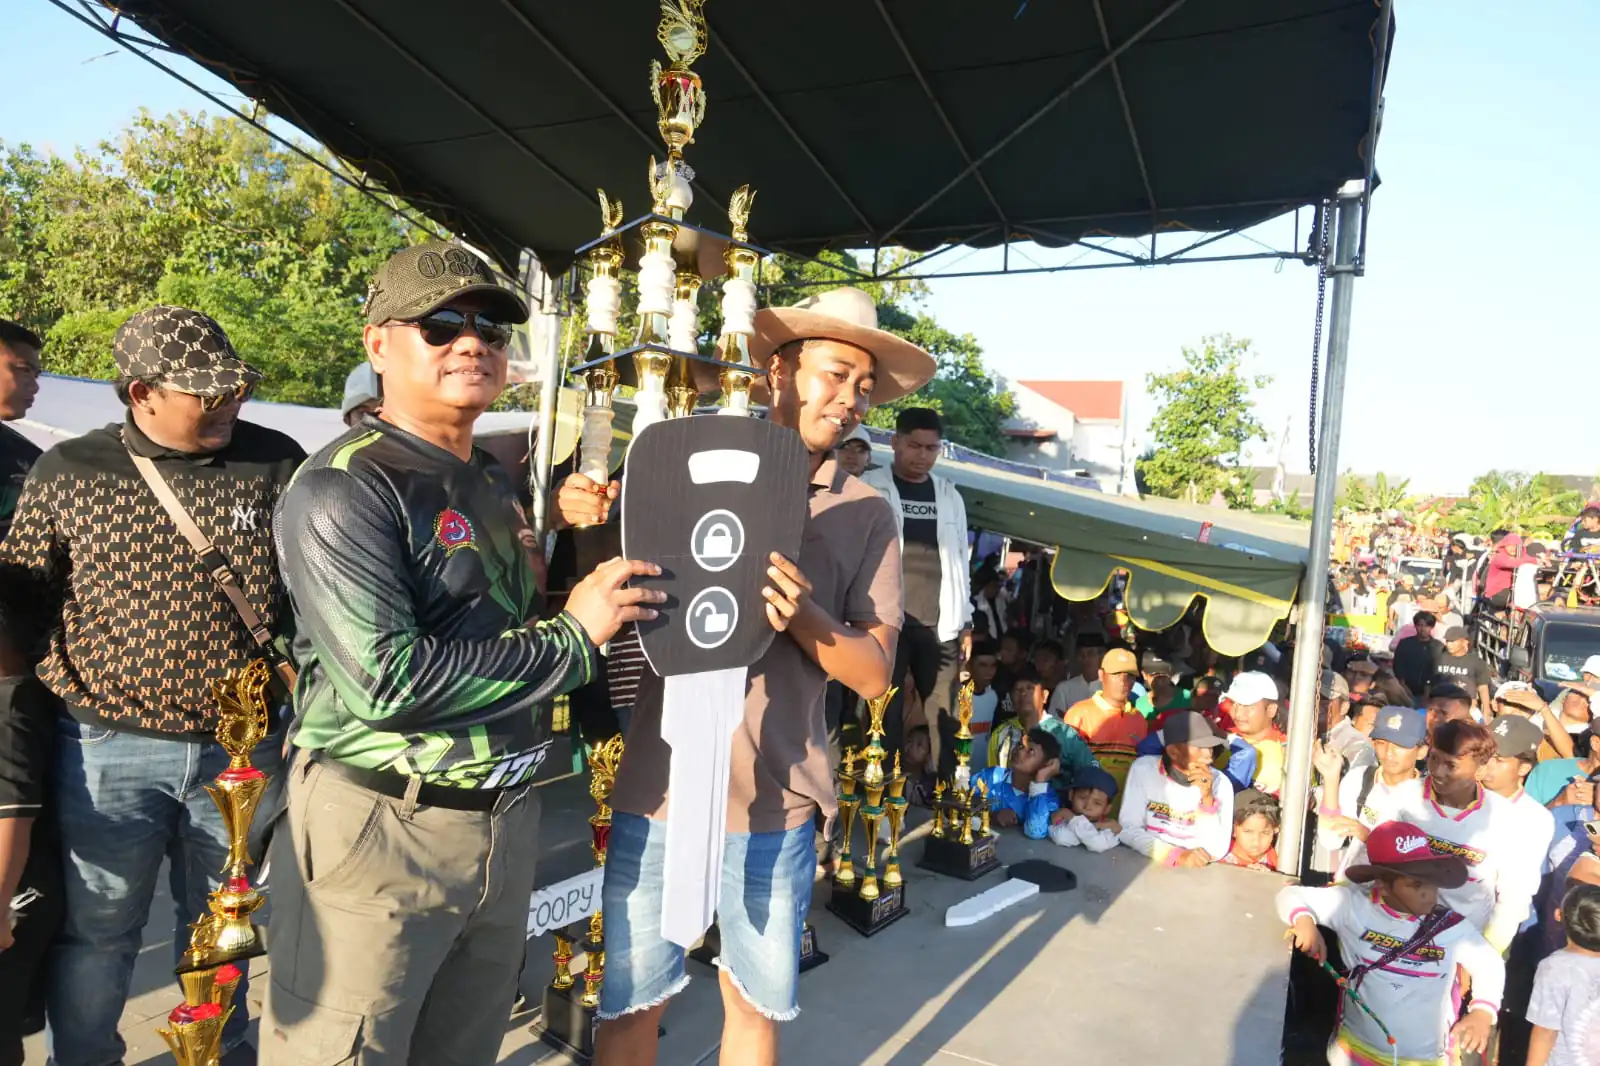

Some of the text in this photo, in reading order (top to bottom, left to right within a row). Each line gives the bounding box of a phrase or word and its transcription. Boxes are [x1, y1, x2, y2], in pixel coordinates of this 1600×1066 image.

[417, 248, 484, 278] 08
[76, 479, 97, 489] NY
[119, 480, 140, 489] NY
[196, 480, 216, 489] NY
[236, 481, 255, 490] NY
[58, 489, 76, 500] NY
[96, 488, 117, 496] NY
[216, 489, 236, 498] NY
[75, 497, 95, 506] NY
[116, 496, 137, 505] NY
[196, 497, 216, 506] NY
[60, 509, 76, 519] NY
[94, 505, 114, 514] NY
[136, 505, 157, 515] NY
[76, 515, 93, 525] NY
[113, 514, 134, 523] NY
[197, 516, 216, 526] NY
[93, 524, 111, 533] NY
[133, 524, 154, 533] NY
[216, 526, 234, 536] NY
[111, 532, 132, 542] NY
[154, 533, 175, 544] NY
[235, 536, 254, 545] NY
[93, 543, 110, 552] NY
[132, 543, 152, 552] NY
[174, 544, 195, 555] NY
[253, 546, 270, 556] NY
[111, 552, 131, 562] NY
[153, 553, 174, 562] NY
[234, 555, 253, 565] NY
[132, 562, 151, 572] NY
[173, 563, 194, 573] NY
[252, 565, 270, 575] NY
[115, 571, 132, 581] NY
[152, 571, 173, 581] NY
[133, 581, 151, 591] NY
[173, 581, 193, 591] NY
[250, 584, 269, 594] NY
[151, 591, 171, 600] NY
[193, 592, 213, 601] NY
[131, 600, 150, 609] NY
[171, 600, 192, 610] NY
[213, 602, 231, 611] NY
[149, 610, 170, 620] NY
[191, 611, 212, 621] NY
[96, 616, 116, 625] NY
[131, 620, 148, 628] NY
[169, 620, 190, 630] NY
[211, 622, 230, 631] NY
[112, 627, 130, 637] NY
[147, 629, 168, 639] NY
[189, 631, 210, 640] NY
[128, 638, 147, 647] NY
[167, 640, 188, 650] NY
[209, 640, 230, 650] NY
[145, 648, 166, 658] NY
[187, 650, 208, 659] NY
[229, 650, 248, 659] NY
[123, 657, 143, 667] NY
[164, 660, 185, 669] NY
[207, 660, 228, 669] NY
[106, 663, 124, 673] NY
[142, 668, 164, 678] NY
[185, 669, 206, 679] NY
[123, 676, 140, 686] NY
[162, 679, 184, 688] NY
[141, 687, 162, 696] NY
[184, 688, 204, 697] NY
[162, 695, 182, 705] NY
[123, 706, 142, 716] NY
[164, 712, 184, 721] NY
[142, 718, 163, 728] NY
[185, 720, 204, 729] NY
